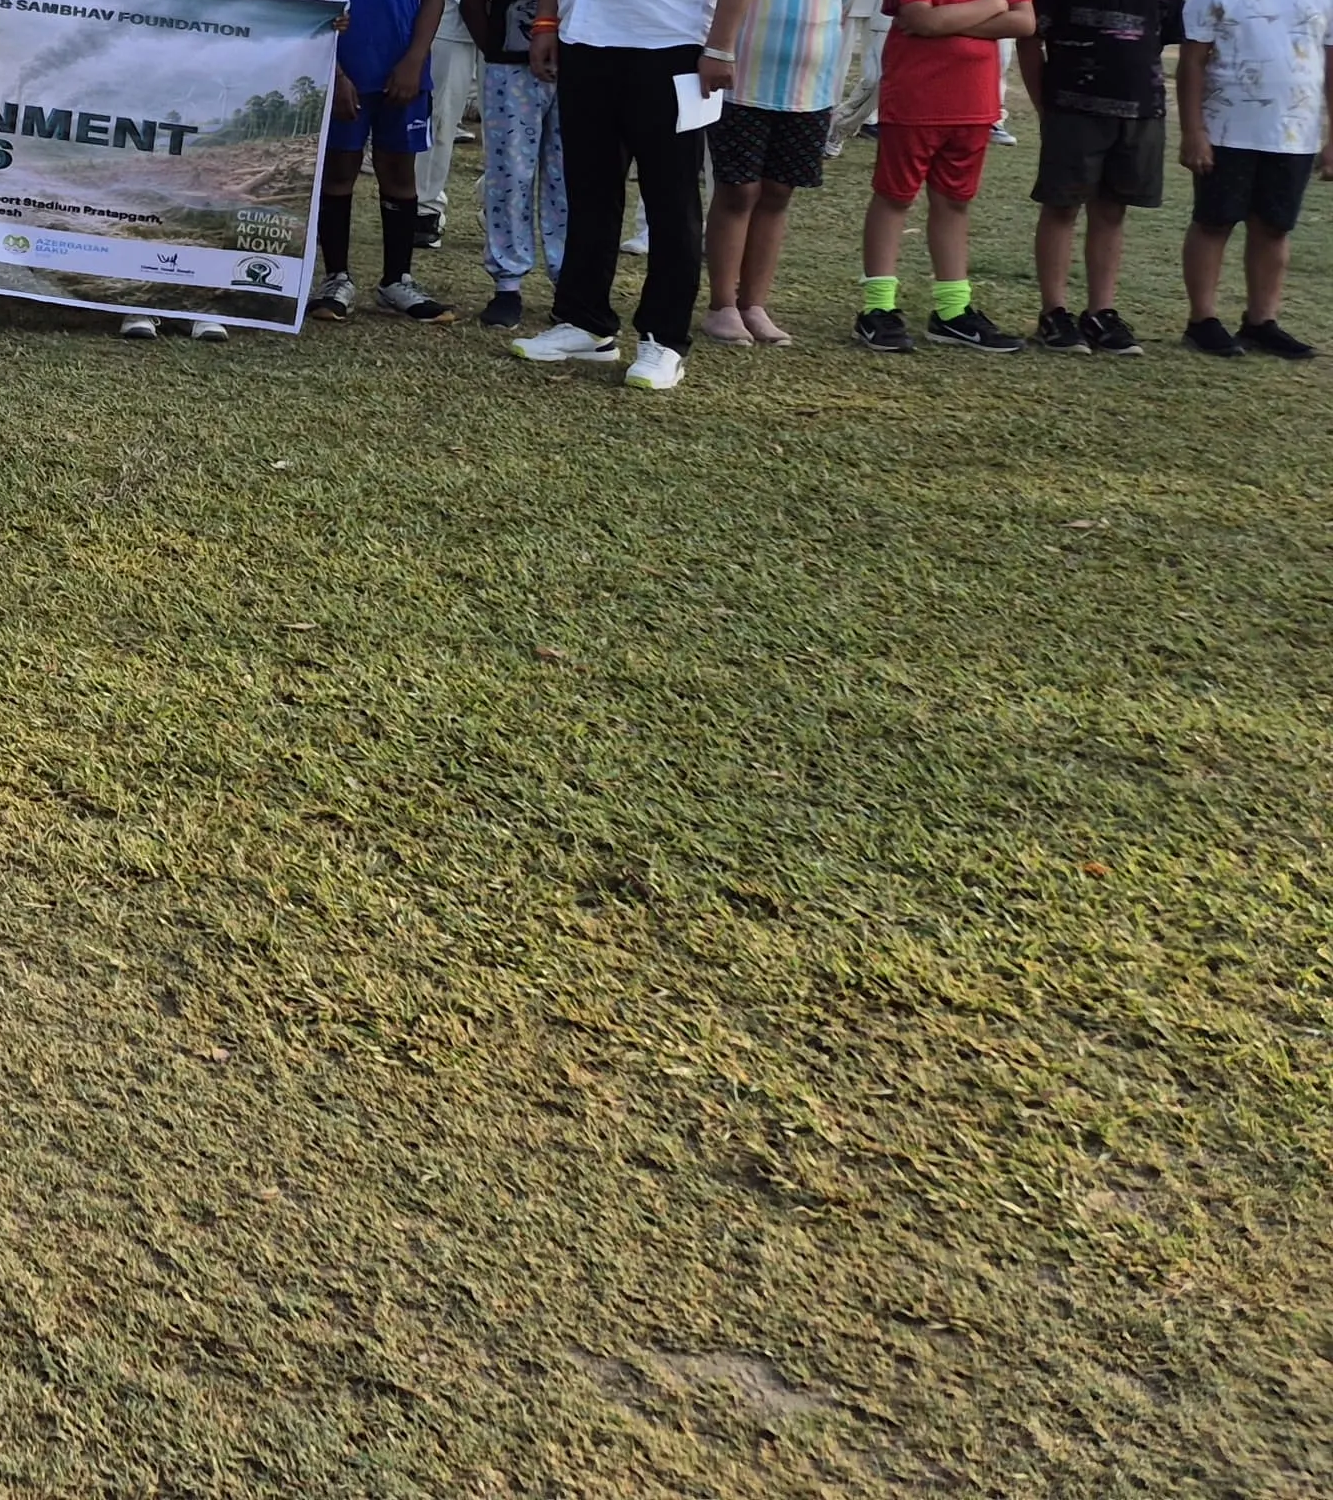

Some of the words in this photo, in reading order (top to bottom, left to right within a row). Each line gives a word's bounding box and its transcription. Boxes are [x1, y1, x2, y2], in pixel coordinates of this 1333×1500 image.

[16, 0, 115, 21] SAMBHAV
[118, 11, 250, 38] FOUNDATION
[23, 196, 80, 214] Stadium
[83, 205, 163, 225] Pratapgarh,
[237, 210, 298, 228] CLIMATE
[237, 222, 292, 241] ACTION
[237, 235, 287, 254] NOW
